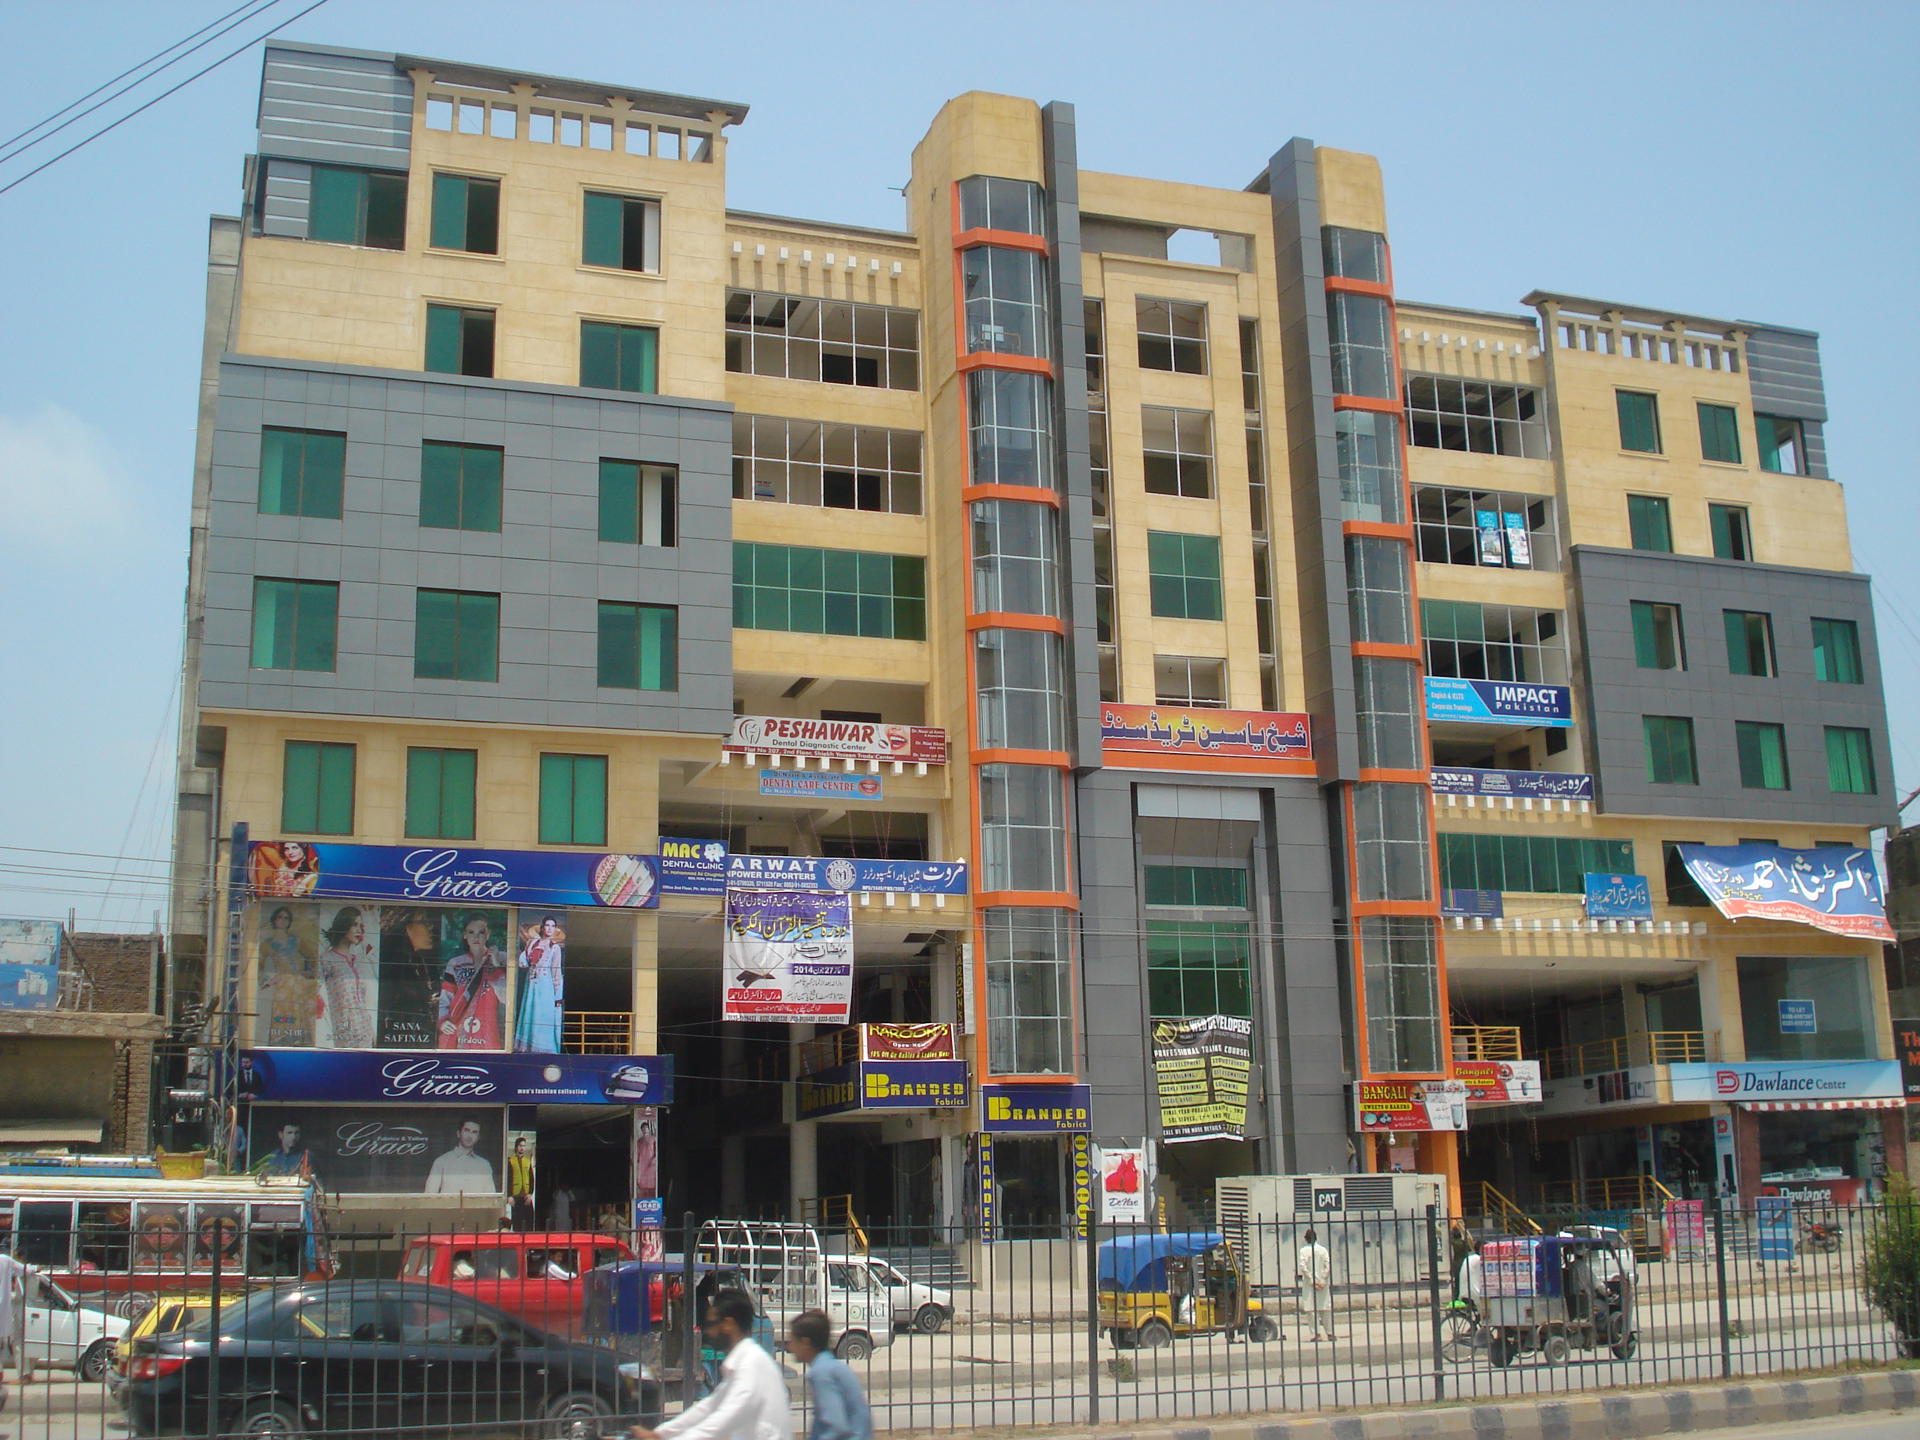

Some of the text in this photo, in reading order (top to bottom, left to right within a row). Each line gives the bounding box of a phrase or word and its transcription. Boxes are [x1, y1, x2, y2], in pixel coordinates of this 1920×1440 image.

[1495, 686, 1558, 704] IMPACT
[1496, 702, 1560, 713] Pakistan
[764, 719, 875, 745] PESHAWAR
[1151, 711, 1196, 746] ٹریڈ
[1199, 720, 1265, 750] یاسین
[1266, 722, 1307, 751] شیخ
[772, 739, 866, 751] Dental Diagnostic Center
[763, 778, 854, 791] DENTAL CARE CENTRE
[1438, 779, 1474, 787] Exporters
[663, 842, 700, 859] MAC
[663, 860, 724, 870] DENTAL CLINIC
[403, 849, 511, 898] Grace
[764, 872, 816, 880] EXPORTERS
[908, 869, 920, 883] مین
[922, 865, 965, 888] مروت
[1742, 857, 1788, 890] احمد
[794, 966, 813, 974] 2014
[393, 1022, 421, 1031] SANA
[1207, 1015, 1251, 1034] DEVELOPERS
[384, 1034, 430, 1043] SAFINAZ
[1154, 1047, 1200, 1057] PROFESSIONAL
[382, 1059, 497, 1096] Grace
[1743, 1071, 1846, 1092] Dawlance Center
[866, 1074, 964, 1098] BRANDED
[1363, 1085, 1407, 1100] BANGALI
[935, 1097, 964, 1106] Fabrics
[988, 1096, 1087, 1121] BRANDED
[1056, 1121, 1087, 1129] Fabrics
[337, 1122, 428, 1156] Grace
[1318, 1193, 1337, 1207] CAT
[862, 1304, 885, 1320] ptcl
